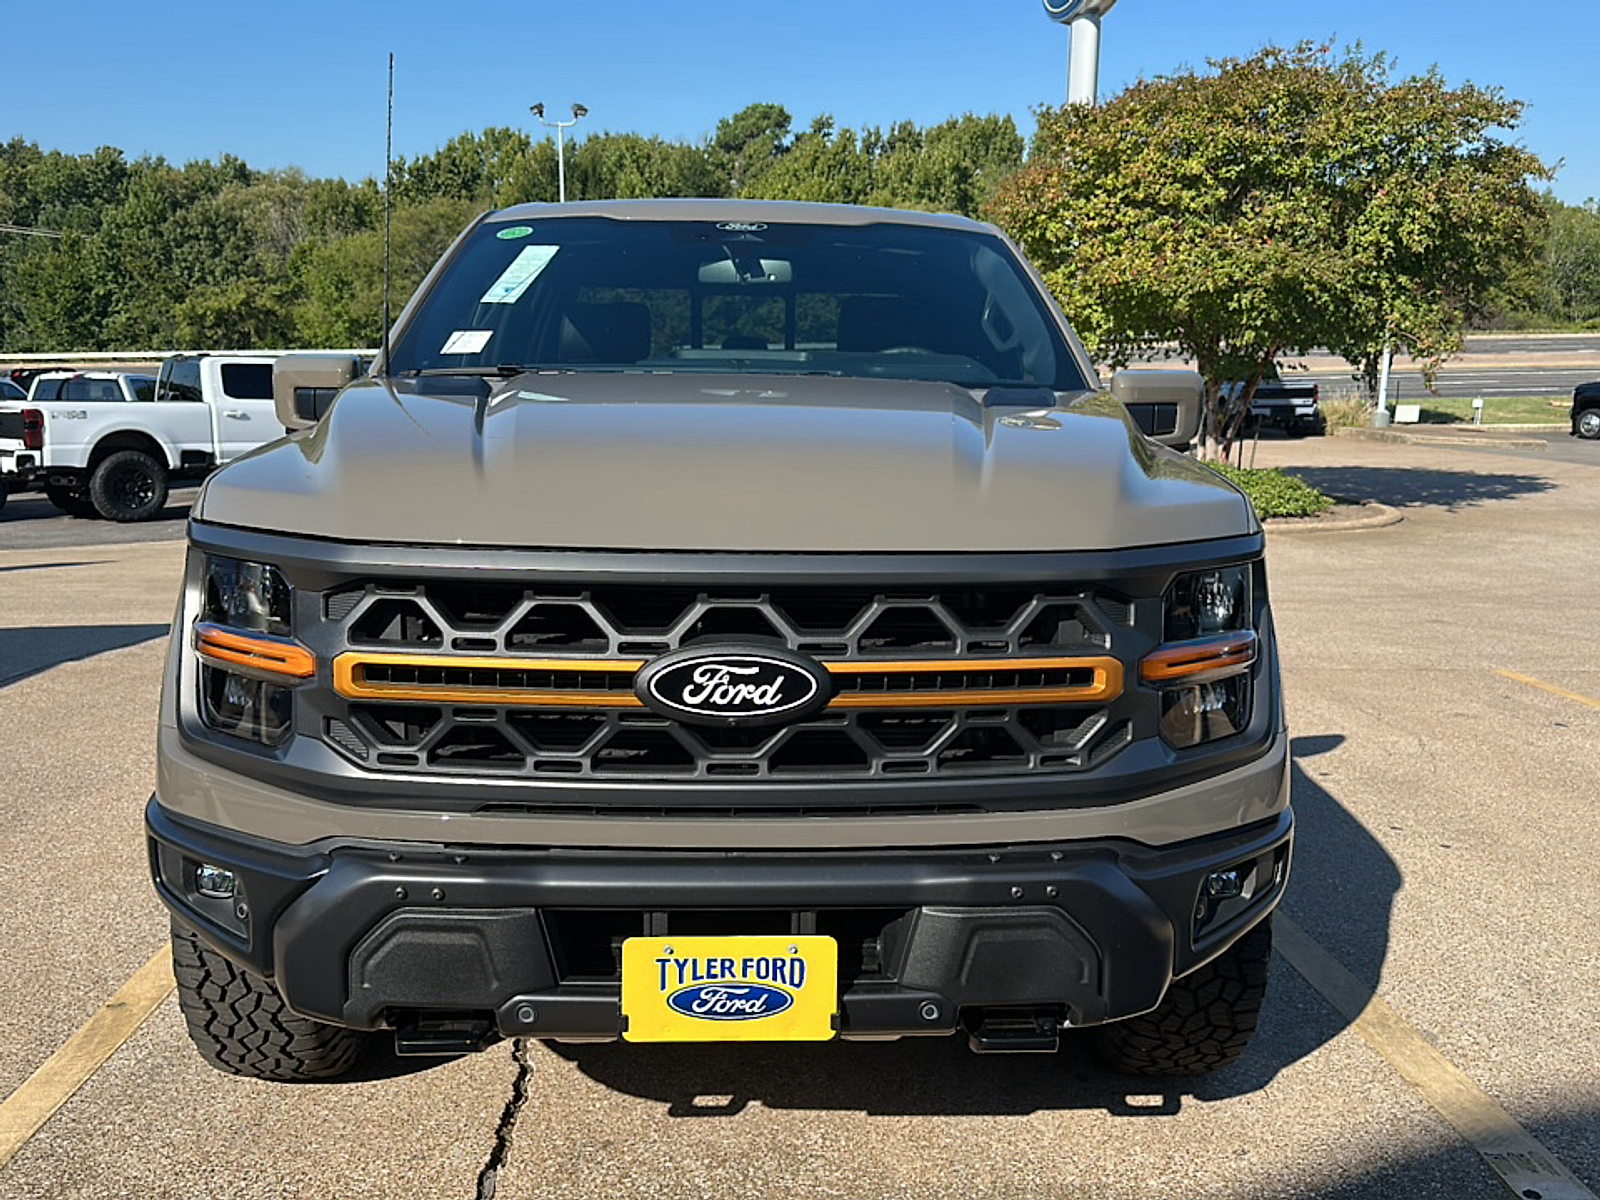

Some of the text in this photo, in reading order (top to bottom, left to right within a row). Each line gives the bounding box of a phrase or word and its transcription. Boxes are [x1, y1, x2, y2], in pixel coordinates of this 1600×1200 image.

[682, 664, 785, 705] Ford
[655, 956, 806, 991] TYLER FORD
[692, 986, 770, 1014] Ford
